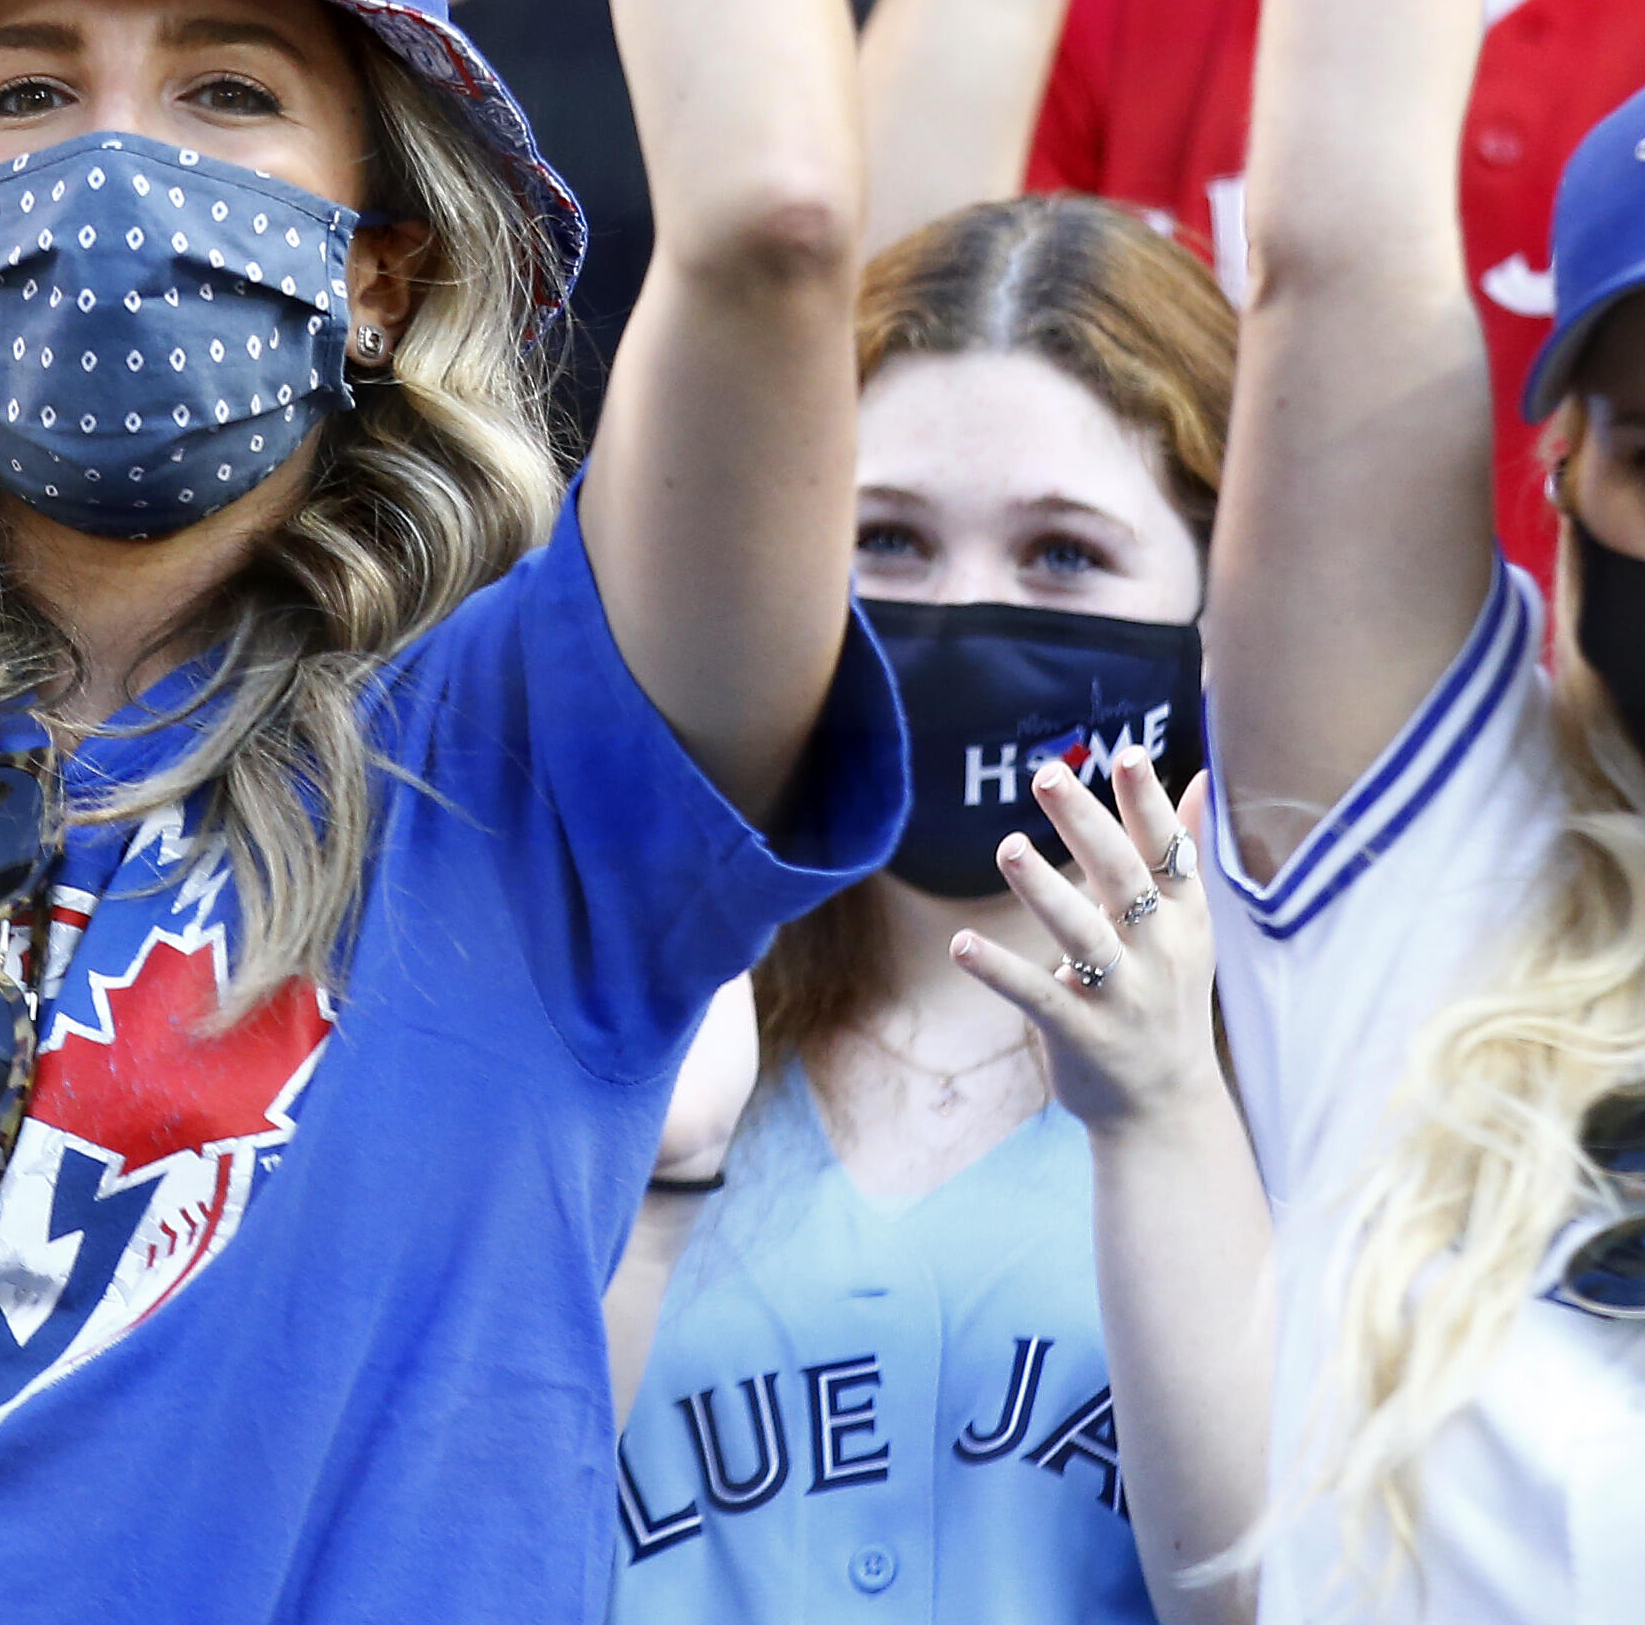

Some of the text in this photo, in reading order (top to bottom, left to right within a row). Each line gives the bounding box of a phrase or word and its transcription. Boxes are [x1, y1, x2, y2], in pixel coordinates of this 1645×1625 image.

[964, 700, 1172, 807] HME
[615, 1334, 1132, 1567] LUE JA
